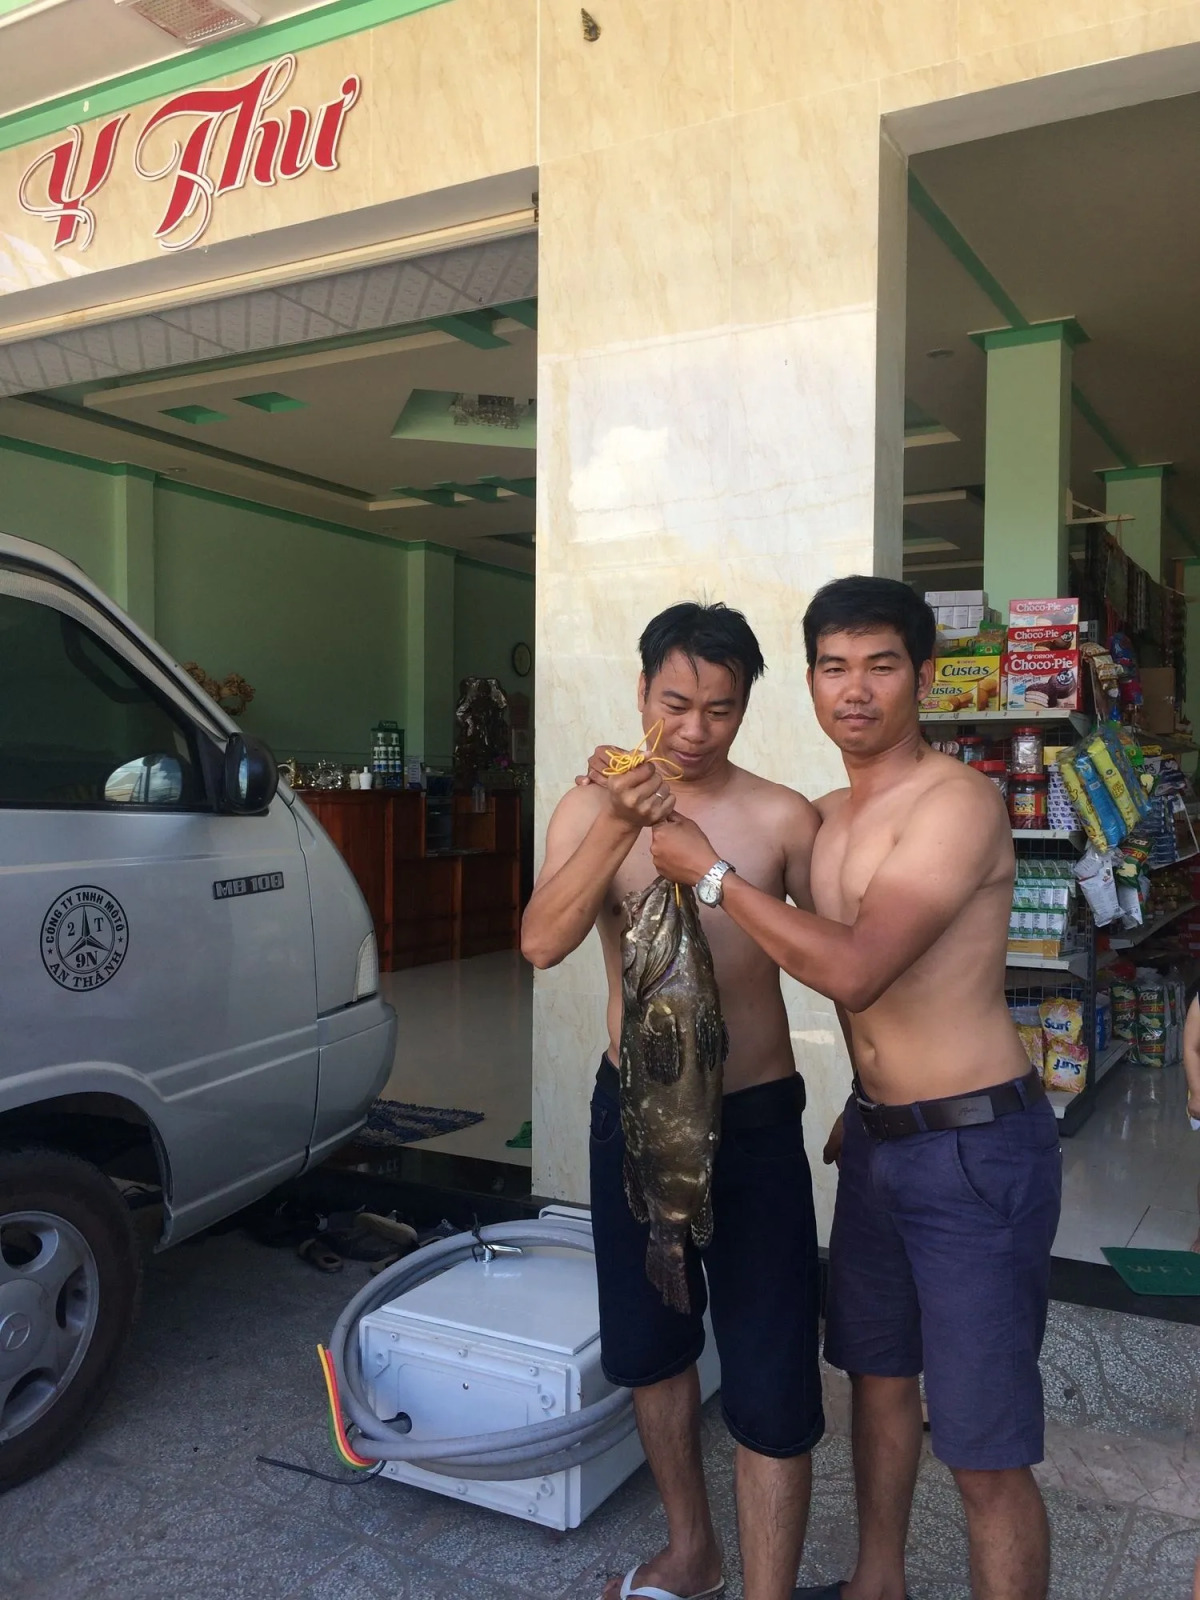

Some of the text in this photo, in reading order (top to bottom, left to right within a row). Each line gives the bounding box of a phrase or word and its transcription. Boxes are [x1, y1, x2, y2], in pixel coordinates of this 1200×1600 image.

[941, 664, 991, 677] Custas
[930, 686, 963, 695] ustas
[214, 873, 283, 897] MB 100
[45, 908, 63, 944] CÔNG
[60, 896, 74, 910] TY
[76, 891, 105, 905] TNHH
[93, 917, 104, 932] T
[67, 921, 76, 937] 2
[75, 950, 98, 968] 9N
[49, 962, 71, 983] AN
[1044, 1017, 1072, 1032] Surf
[1052, 1058, 1082, 1075] Surf
